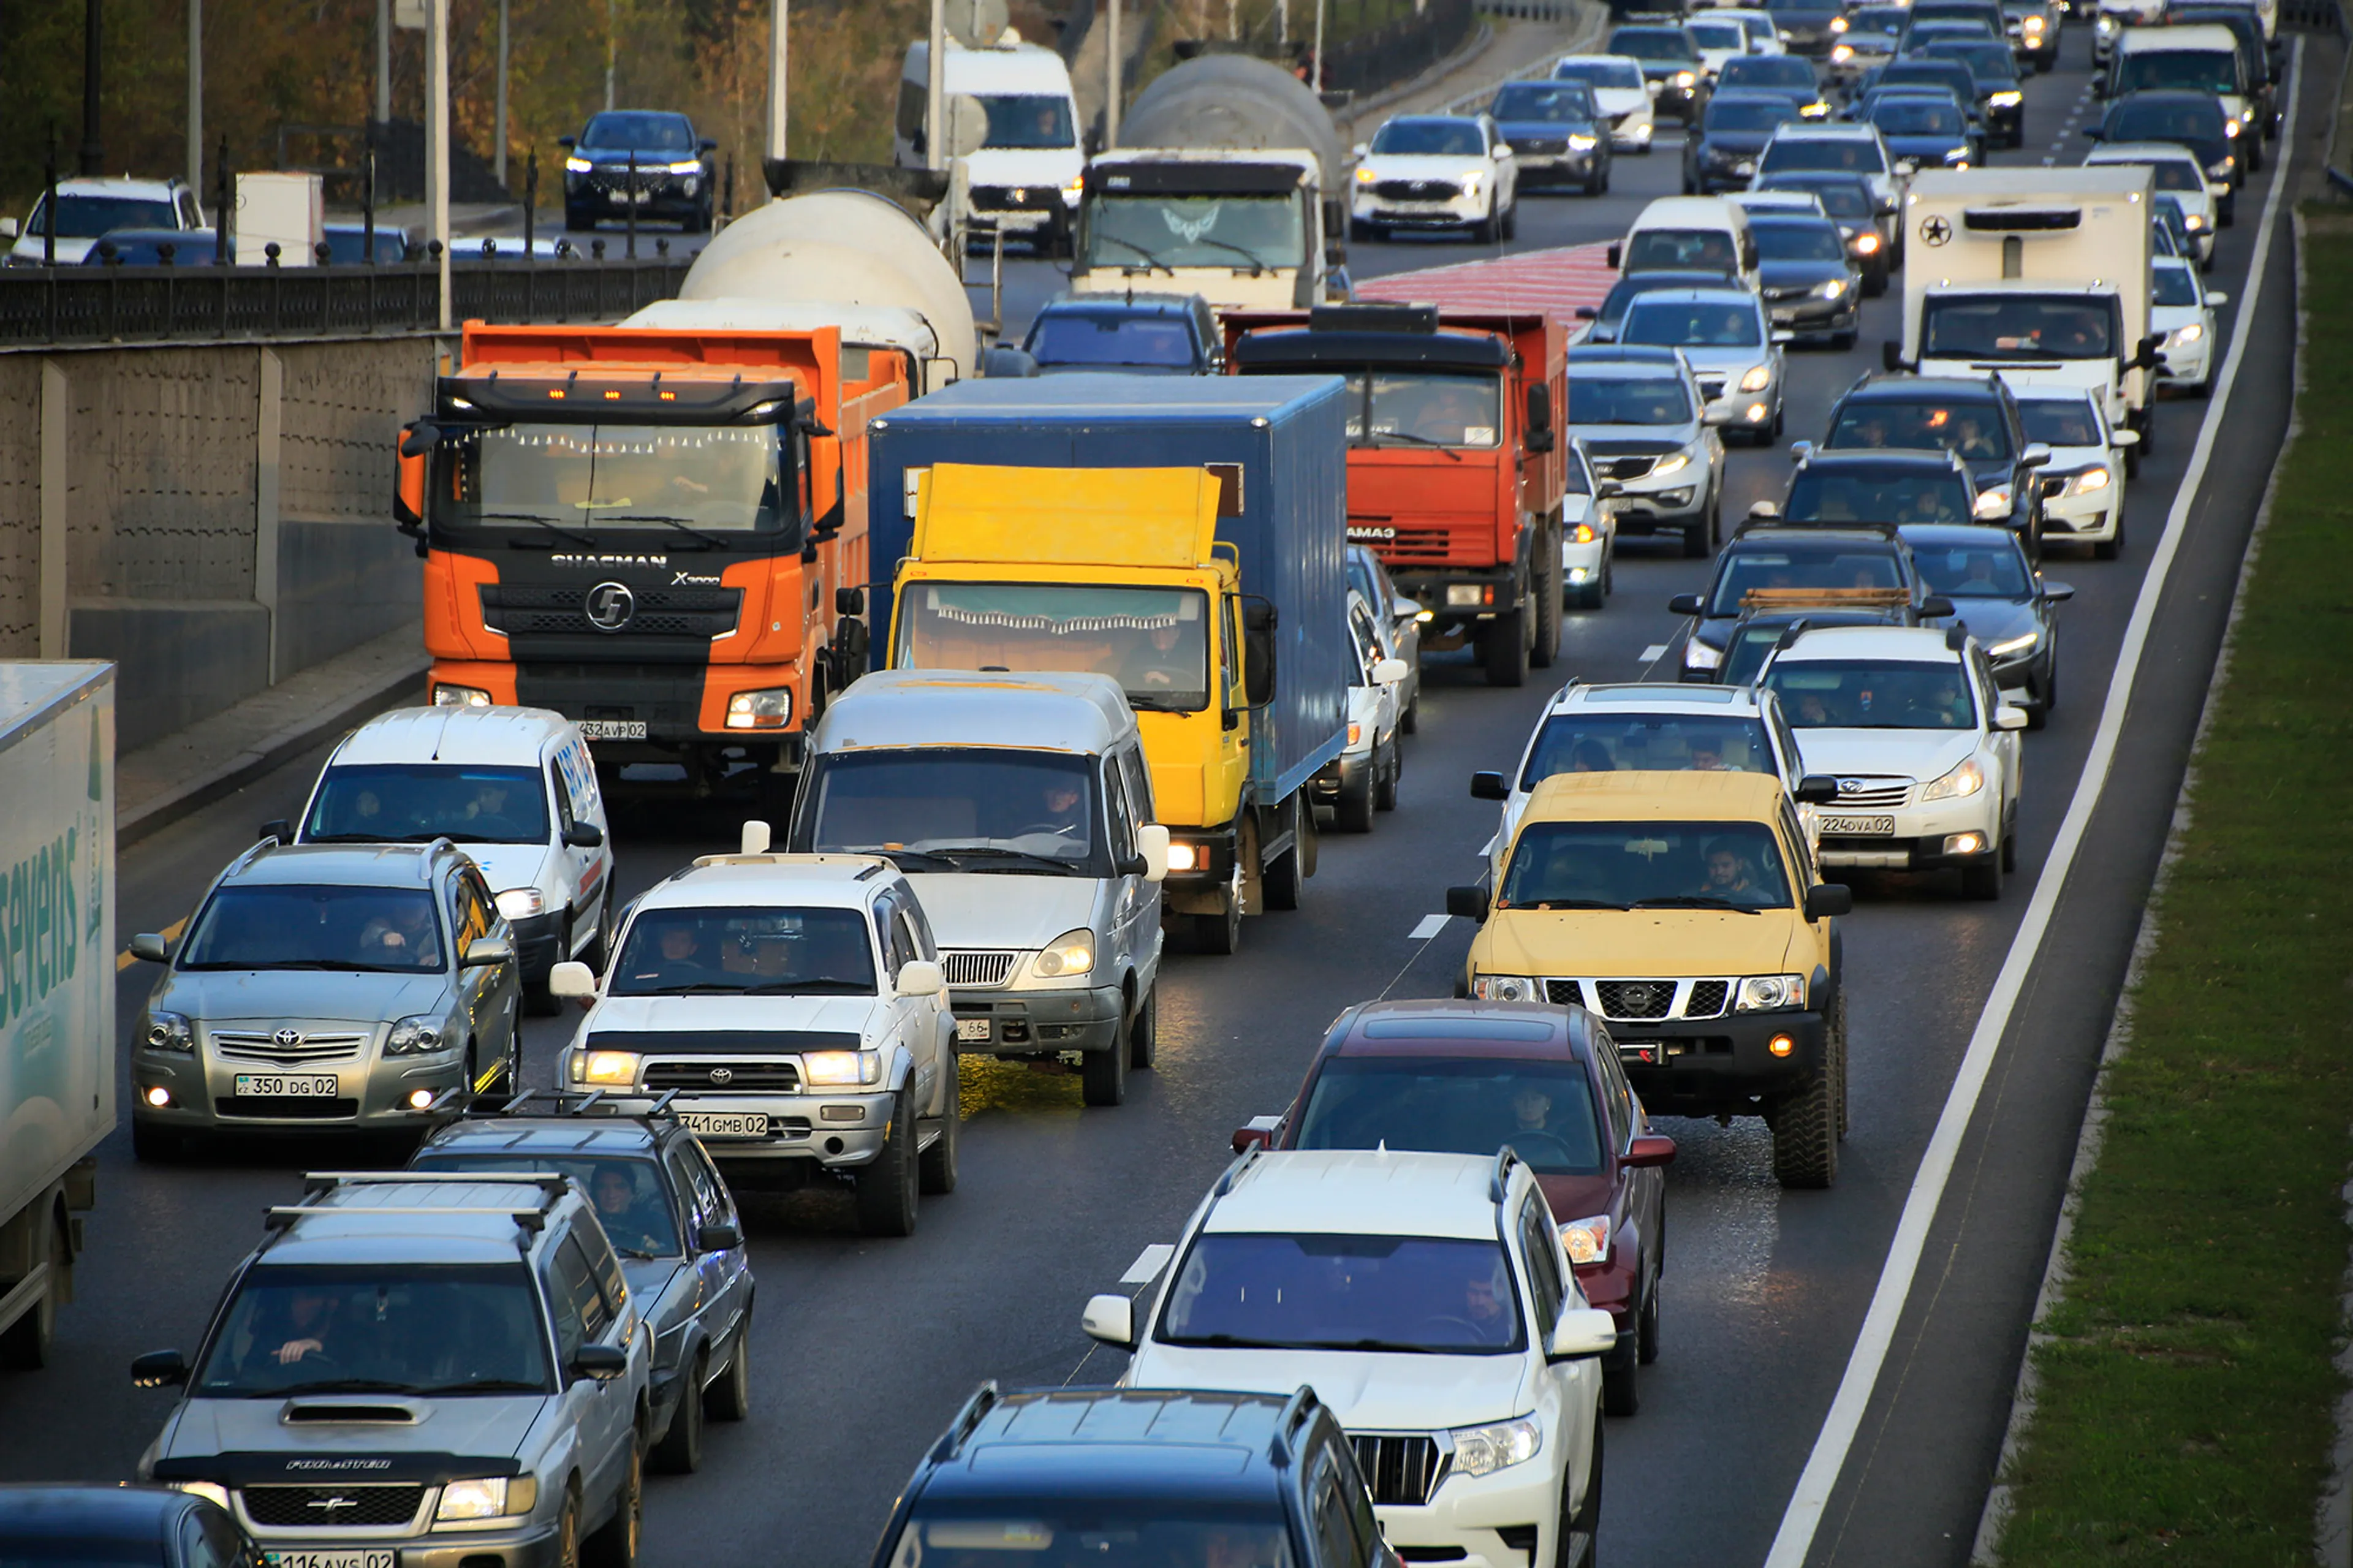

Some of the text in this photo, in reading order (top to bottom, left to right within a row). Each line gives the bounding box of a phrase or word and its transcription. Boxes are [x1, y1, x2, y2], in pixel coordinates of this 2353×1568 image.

[1347, 527, 1395, 538] АМАЗ
[551, 554, 667, 569] SHACMAN
[671, 571, 720, 585] X3000
[253, 1078, 283, 1094] 350
[315, 1078, 335, 1094] 02
